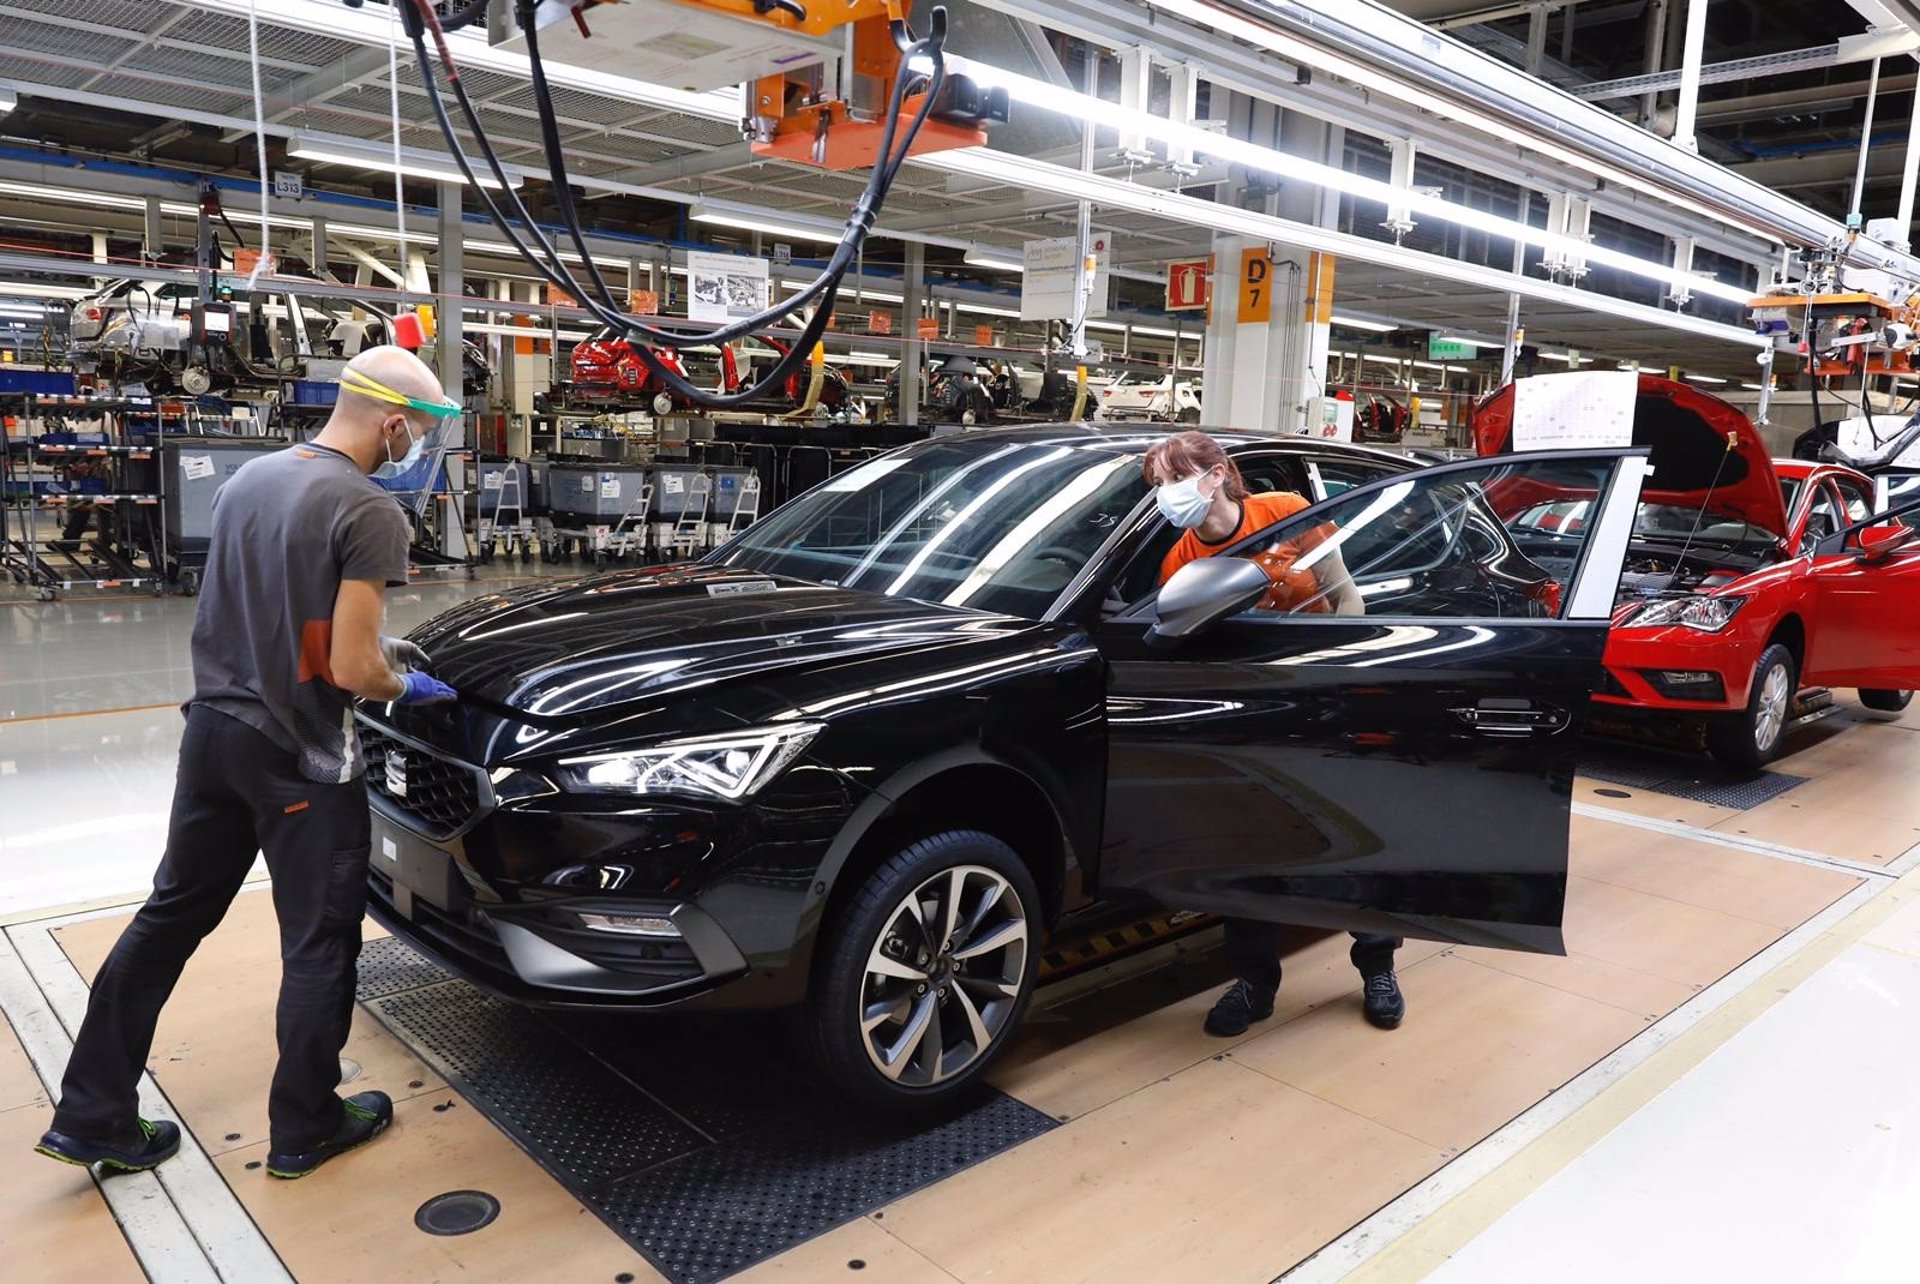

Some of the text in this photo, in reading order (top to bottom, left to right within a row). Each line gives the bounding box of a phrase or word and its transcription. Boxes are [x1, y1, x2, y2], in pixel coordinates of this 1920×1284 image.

[276, 182, 300, 194] L313
[1248, 259, 1266, 284] D
[1249, 288, 1261, 308] 7
